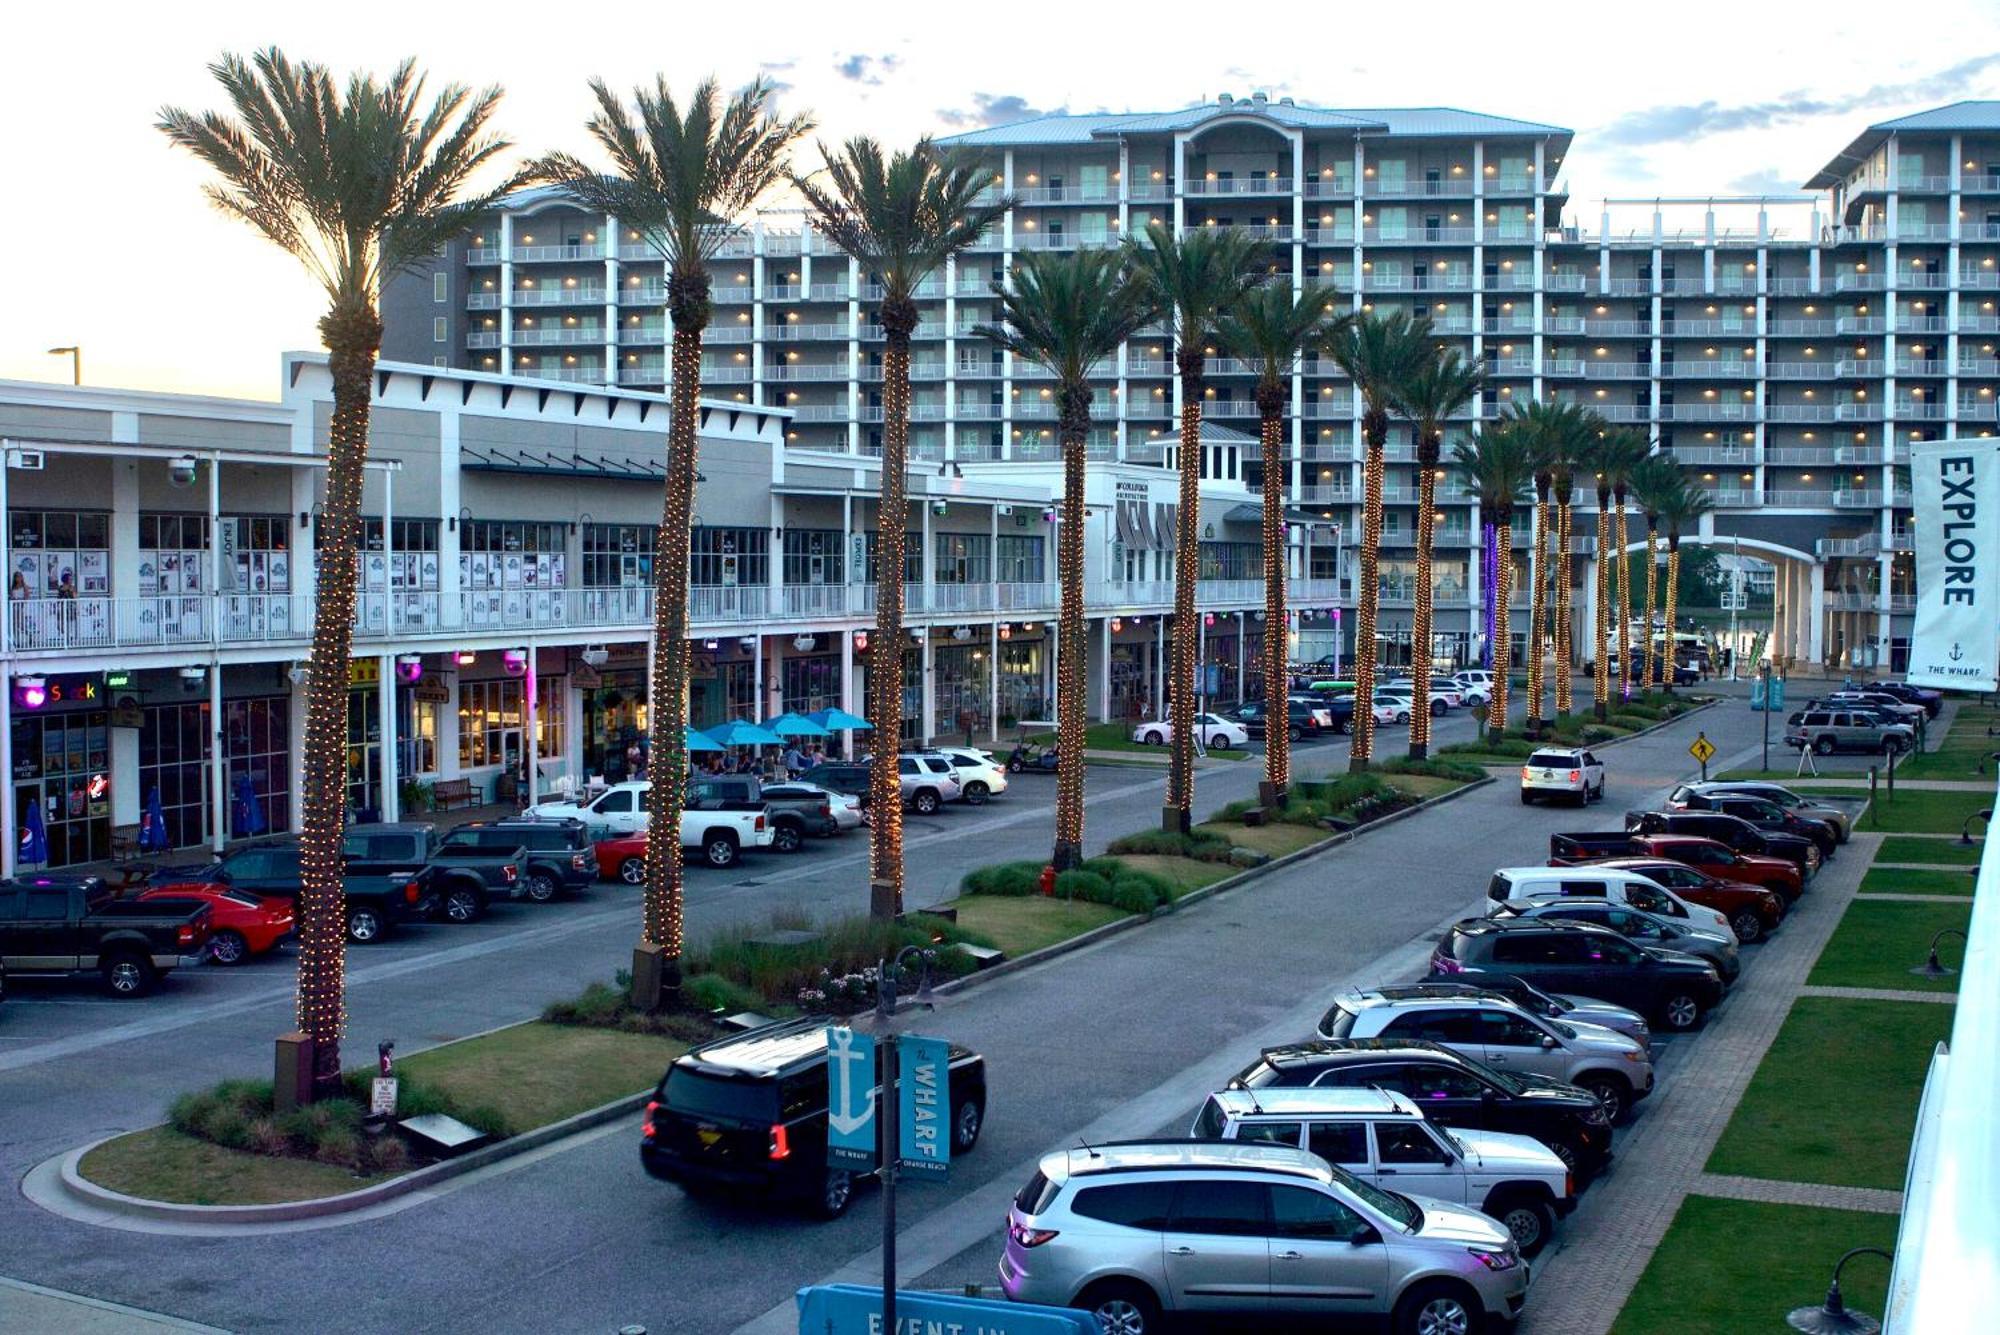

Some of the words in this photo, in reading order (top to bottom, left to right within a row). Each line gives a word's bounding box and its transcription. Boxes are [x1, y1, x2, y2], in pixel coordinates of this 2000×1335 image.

[223, 523, 233, 556] ENJOY
[1940, 456, 1976, 606] EXPLORE
[1928, 665, 1945, 674] THE
[1947, 667, 1981, 677] WHARF
[915, 1063, 938, 1158] WHARF
